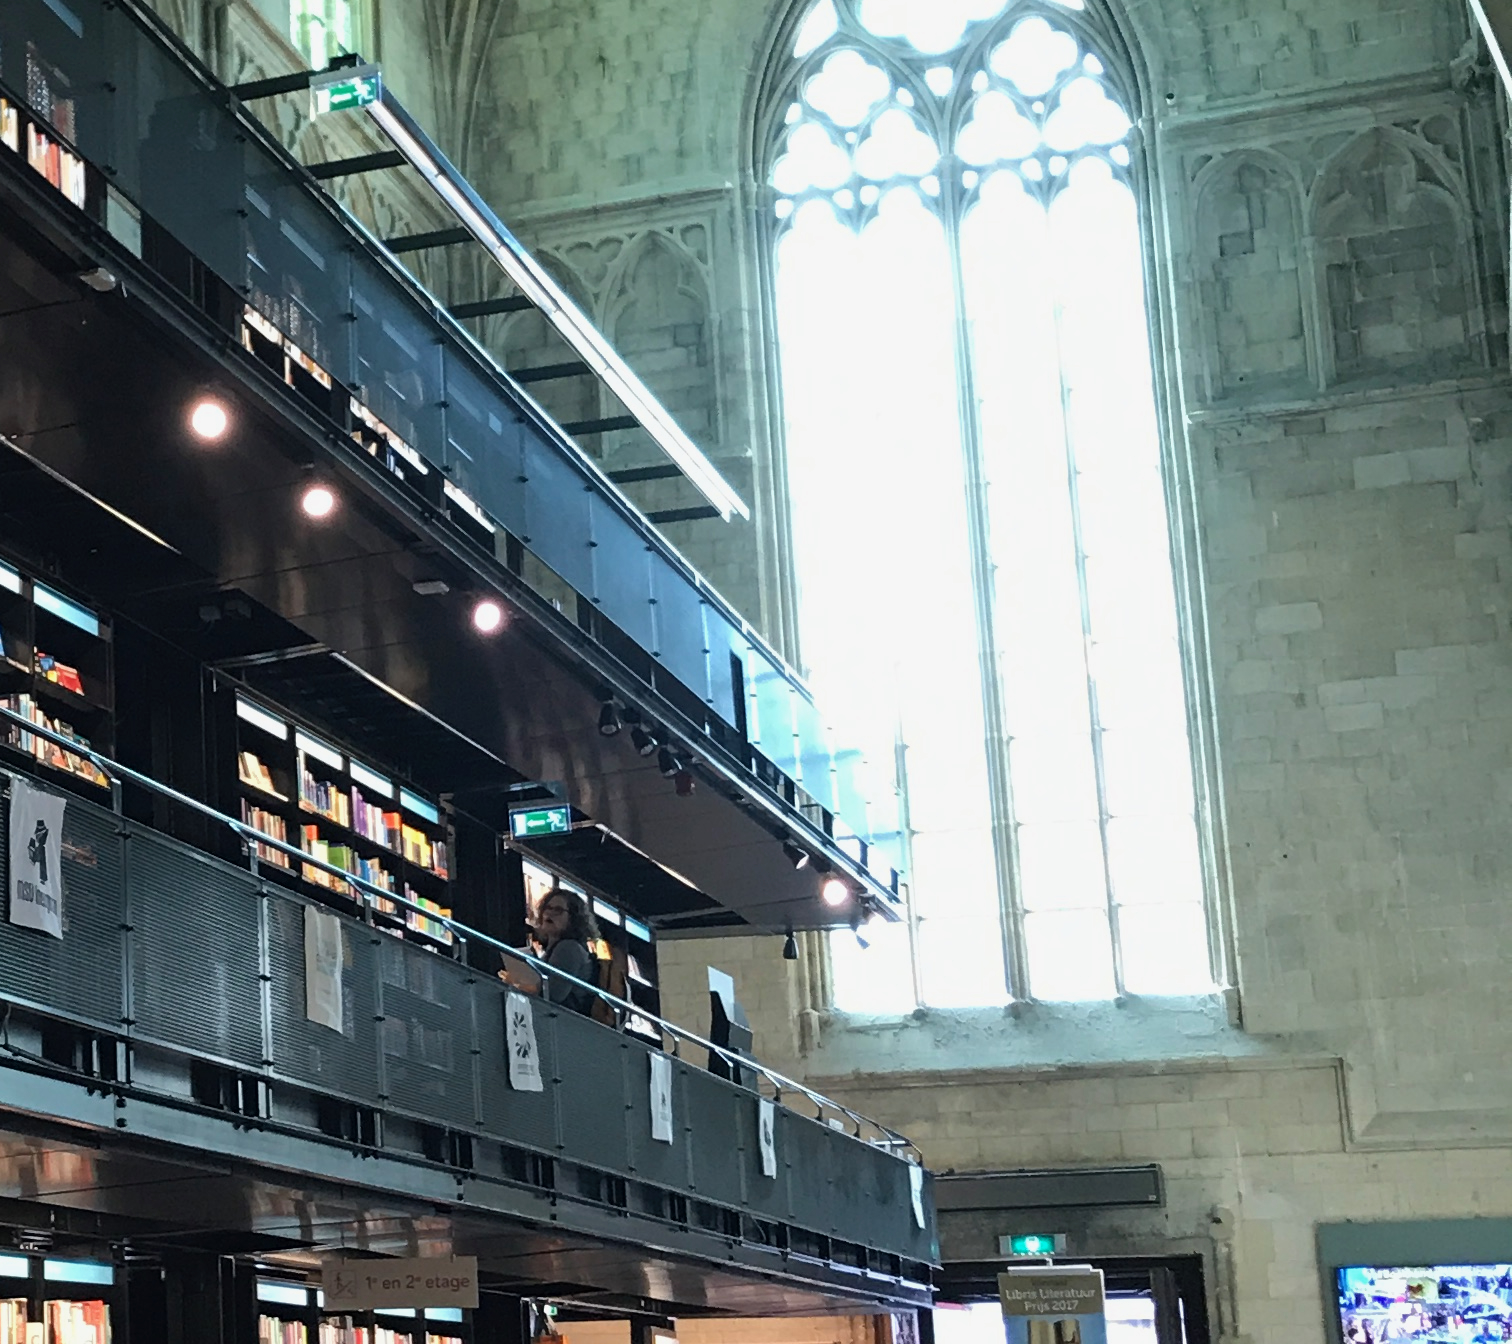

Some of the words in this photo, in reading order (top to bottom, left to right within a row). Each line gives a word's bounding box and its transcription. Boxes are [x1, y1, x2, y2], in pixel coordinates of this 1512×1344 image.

[382, 1278, 401, 1290] en
[425, 1274, 470, 1292] etage
[1005, 1289, 1037, 1300] Libris
[1038, 1288, 1096, 1300] Literatuur
[1024, 1301, 1051, 1313] Prijs
[1052, 1300, 1079, 1311] 2017
